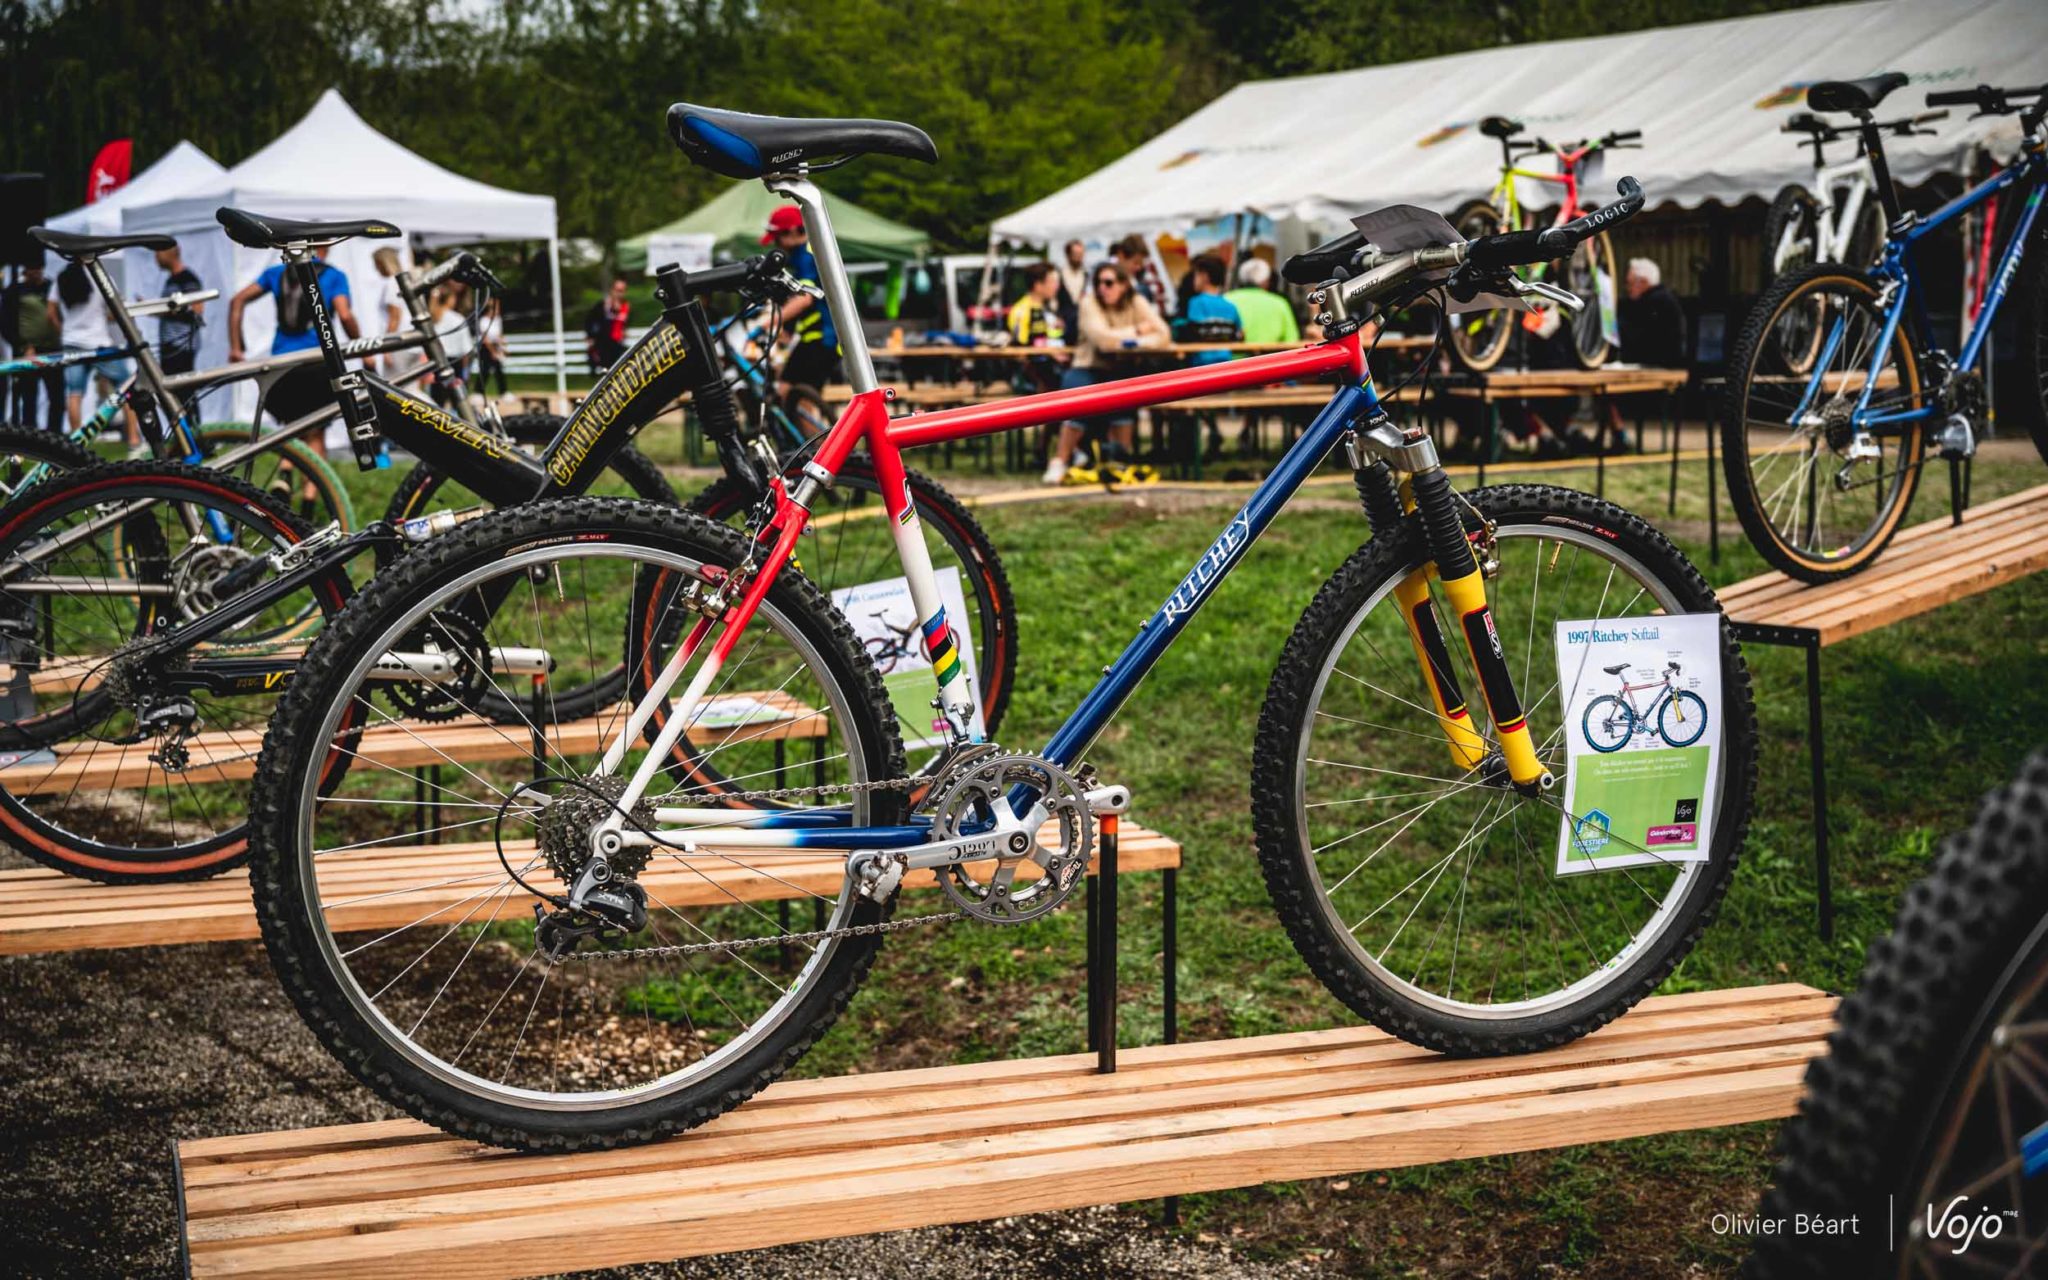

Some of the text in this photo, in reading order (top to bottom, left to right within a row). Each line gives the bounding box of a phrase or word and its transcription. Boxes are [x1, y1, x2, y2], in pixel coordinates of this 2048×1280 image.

[1585, 202, 1629, 228] LOGIC
[308, 283, 334, 349] syncros
[401, 399, 512, 459] RAVEN
[547, 322, 687, 487] CANNONDALE
[1162, 506, 1250, 627] RITCHEY
[1567, 627, 1660, 645] 1997 Ritchey Softail
